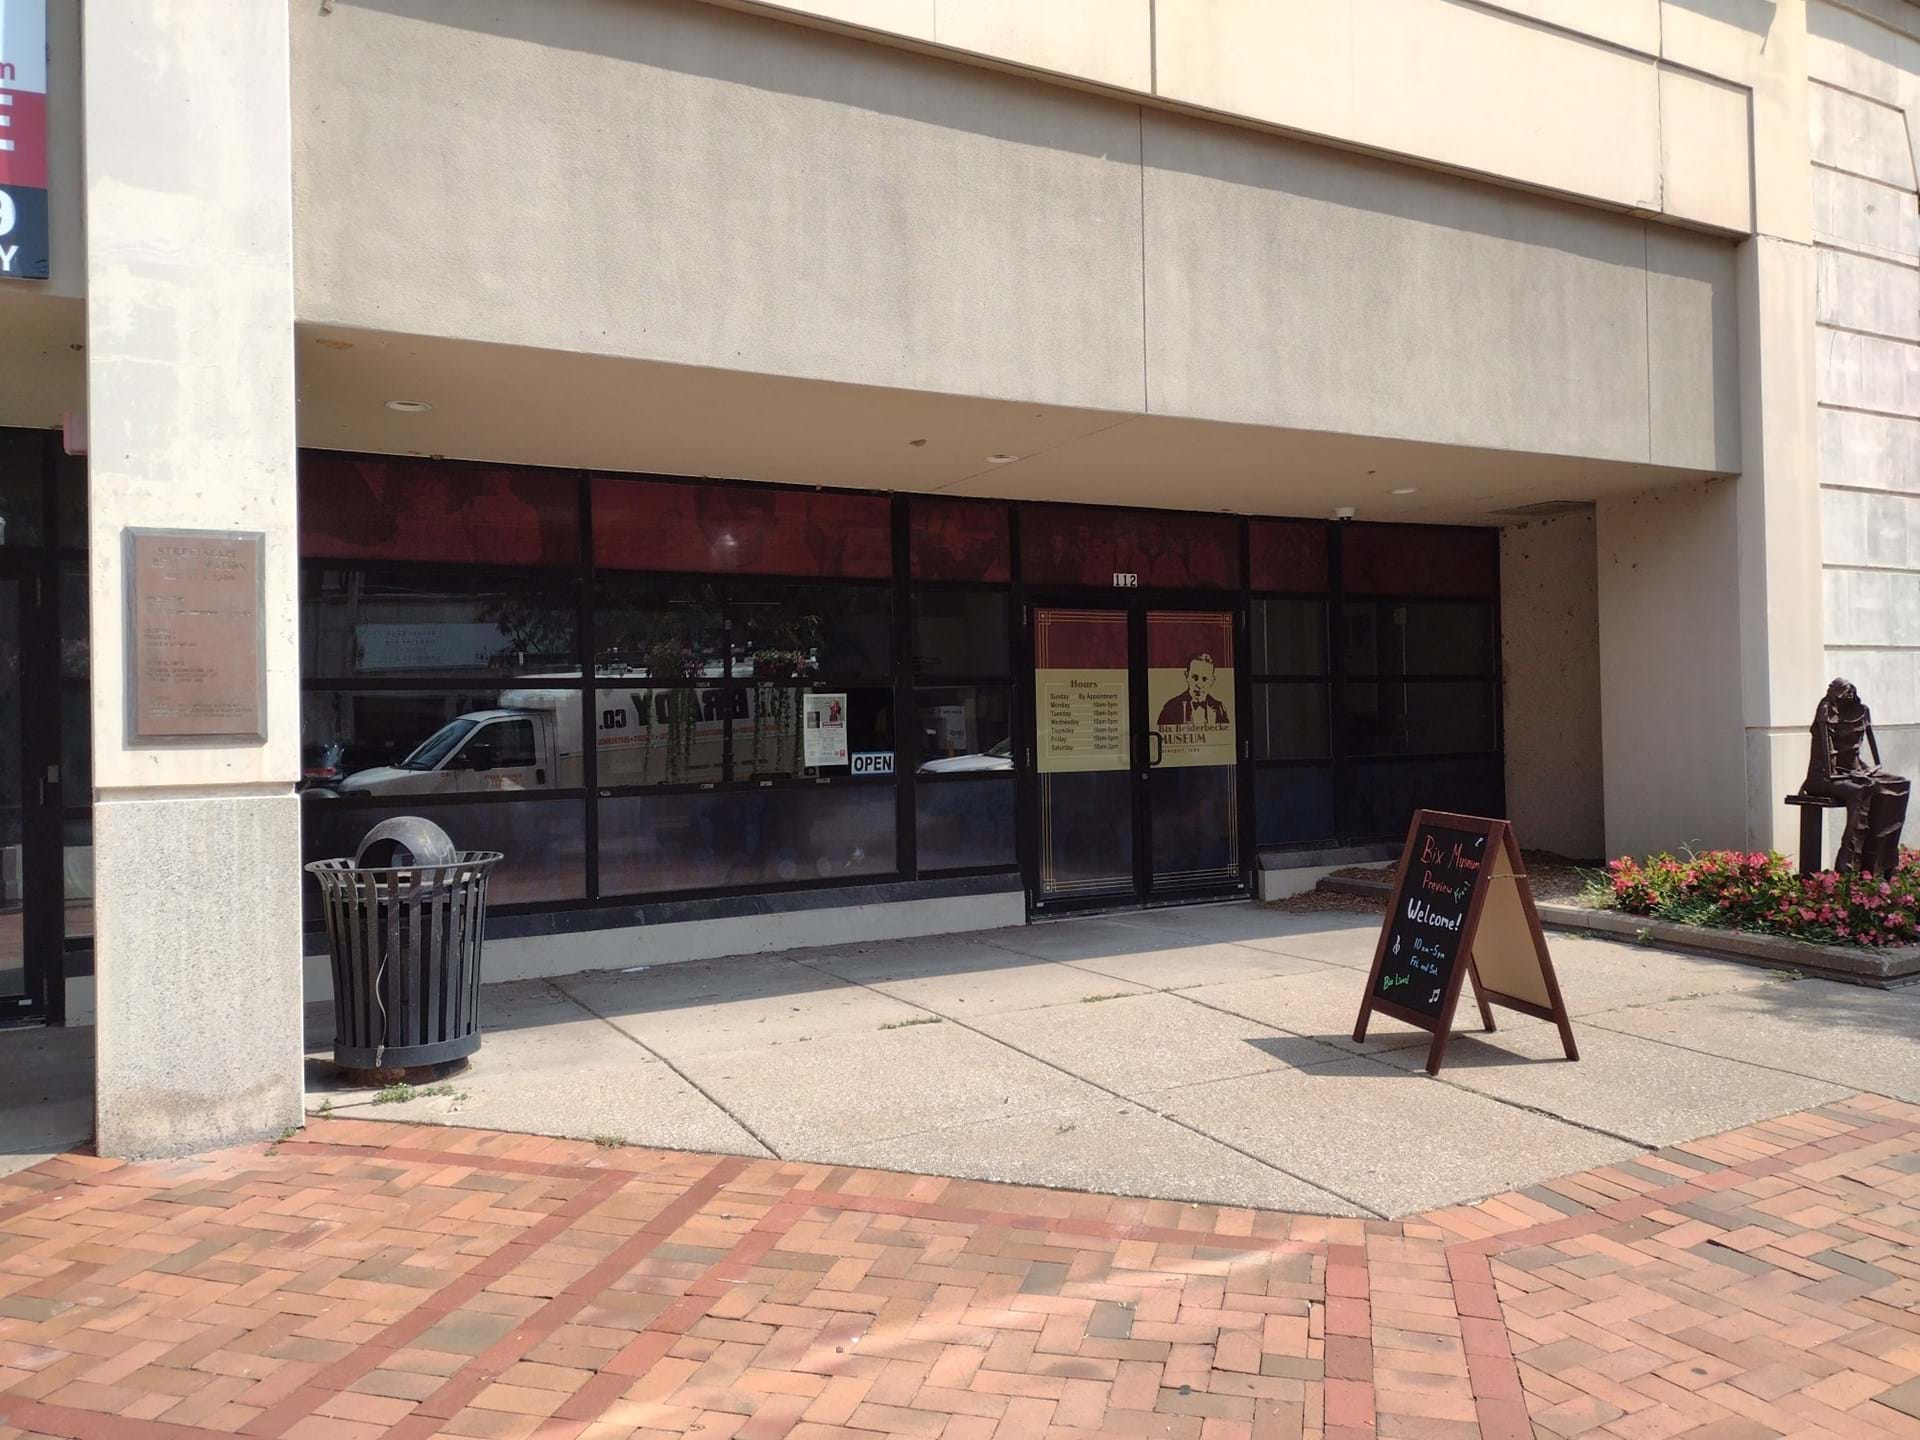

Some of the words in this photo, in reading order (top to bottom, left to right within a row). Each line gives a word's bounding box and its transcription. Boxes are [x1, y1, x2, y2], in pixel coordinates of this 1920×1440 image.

[1115, 575, 1137, 587] 112
[1070, 679, 1098, 689] Hours
[1050, 693, 1069, 702] Sunday
[1078, 693, 1086, 701] By
[1086, 693, 1118, 701] Appointment
[1050, 702, 1070, 710] Monday
[1050, 710, 1071, 718] Tuesday
[1051, 727, 1075, 735] Thursday
[1158, 724, 1173, 733] Bix
[1175, 721, 1229, 733] Beiderbecke
[1051, 736, 1068, 744] Friday
[1051, 744, 1074, 752] Saturday
[854, 755, 892, 772] OPEN
[1420, 834, 1444, 864] Bix
[1448, 842, 1480, 870] Museum
[1422, 870, 1453, 894] Preview
[1407, 897, 1462, 932] Welcome!
